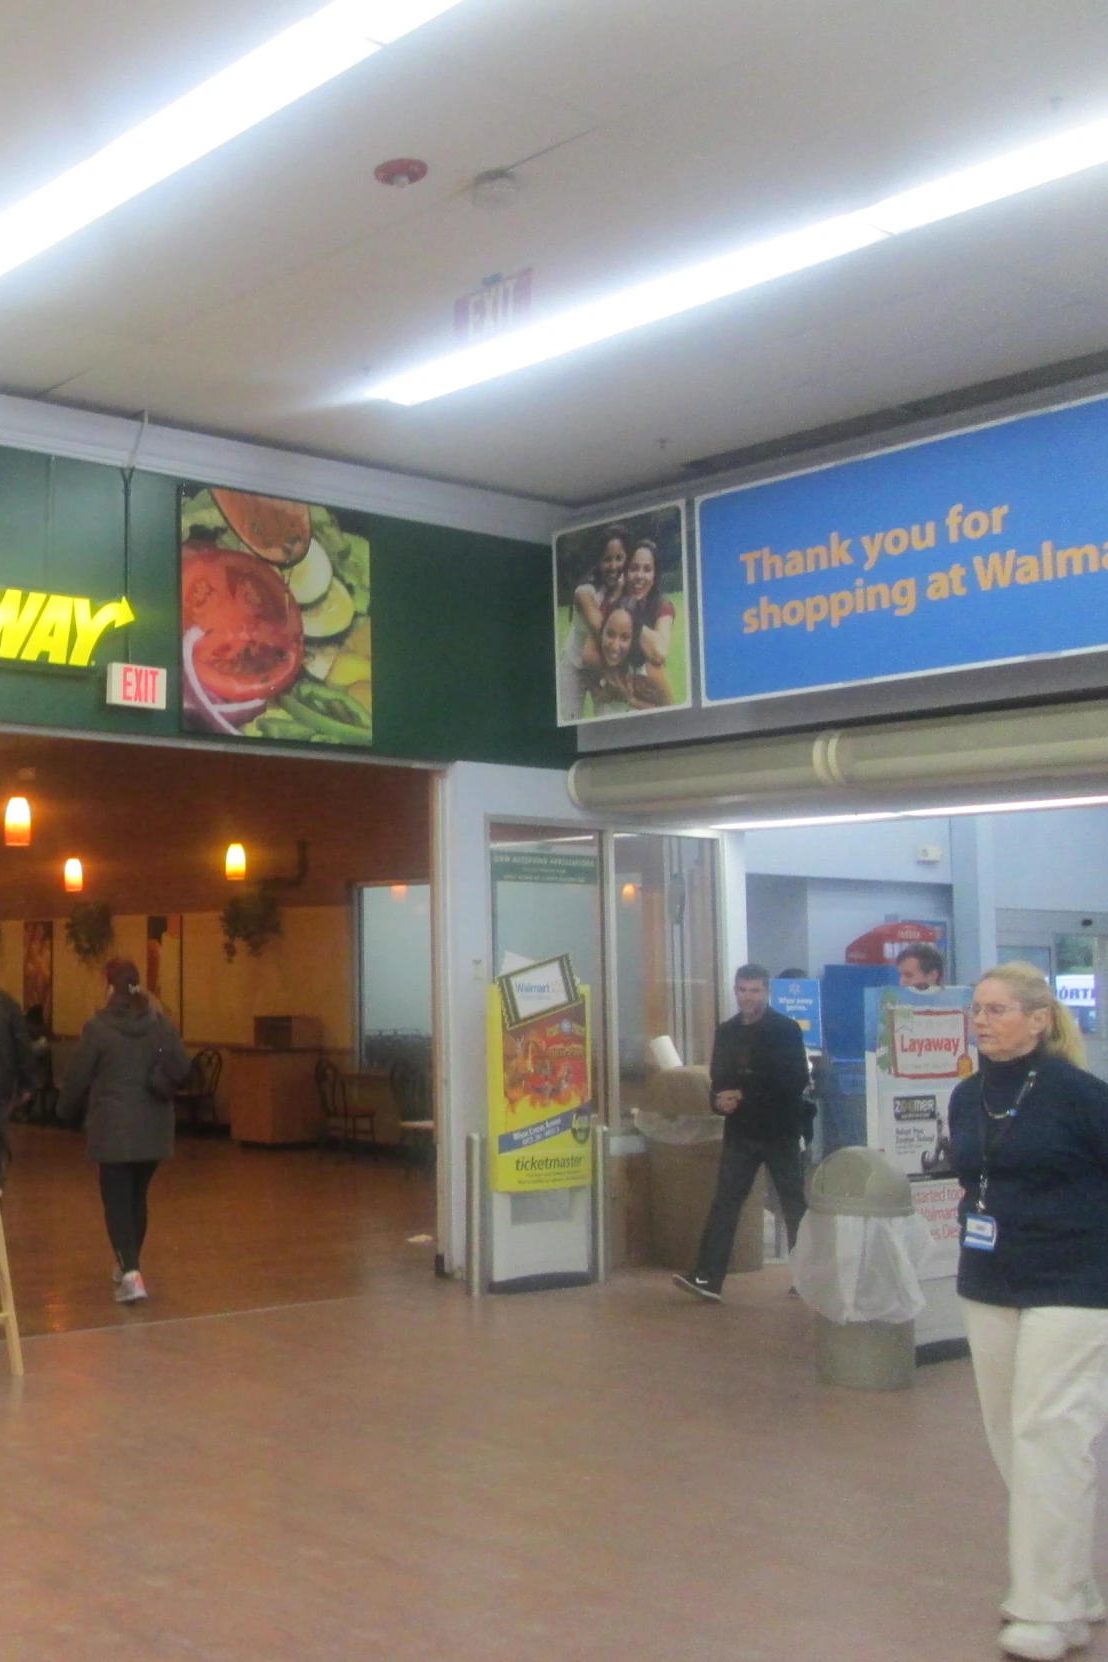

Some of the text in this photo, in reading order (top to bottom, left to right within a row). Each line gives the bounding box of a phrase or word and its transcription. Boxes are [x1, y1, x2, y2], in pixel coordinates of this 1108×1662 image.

[739, 503, 1009, 585] Thank you for
[743, 576, 917, 634] shopping
[926, 564, 967, 601] at
[122, 665, 160, 704] EXIT
[515, 981, 550, 994] Walmart
[900, 1034, 960, 1057] Layaway
[515, 1155, 585, 1172] ticketmaster
